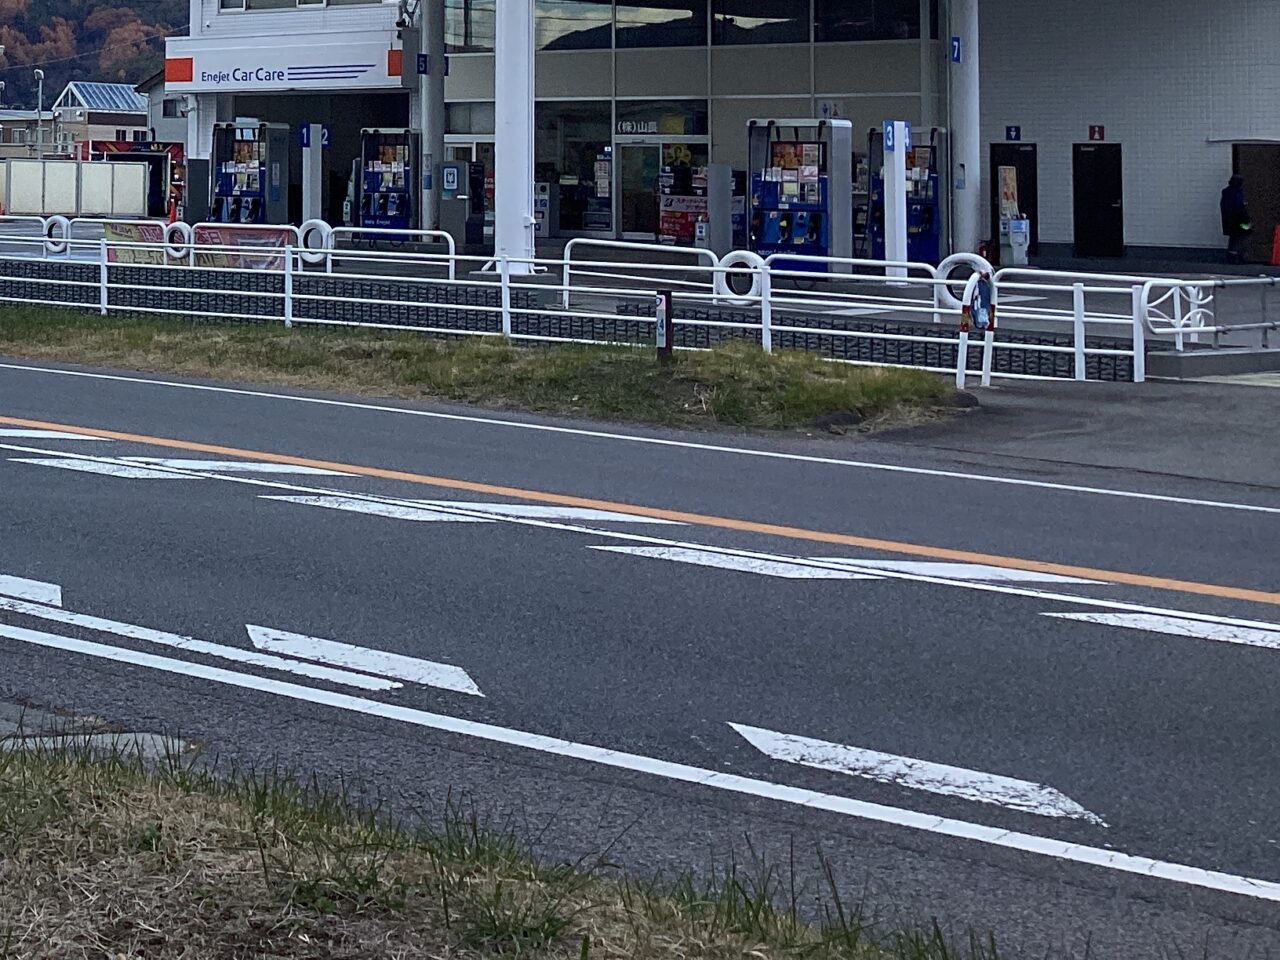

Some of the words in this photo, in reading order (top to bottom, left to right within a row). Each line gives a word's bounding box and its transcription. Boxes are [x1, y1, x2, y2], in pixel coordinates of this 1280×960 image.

[952, 41, 959, 58] 7
[419, 57, 426, 71] 5
[232, 67, 254, 82] Car
[255, 67, 285, 82] Care
[302, 131, 307, 145] 1
[321, 128, 329, 145] 2
[886, 125, 894, 147] 3
